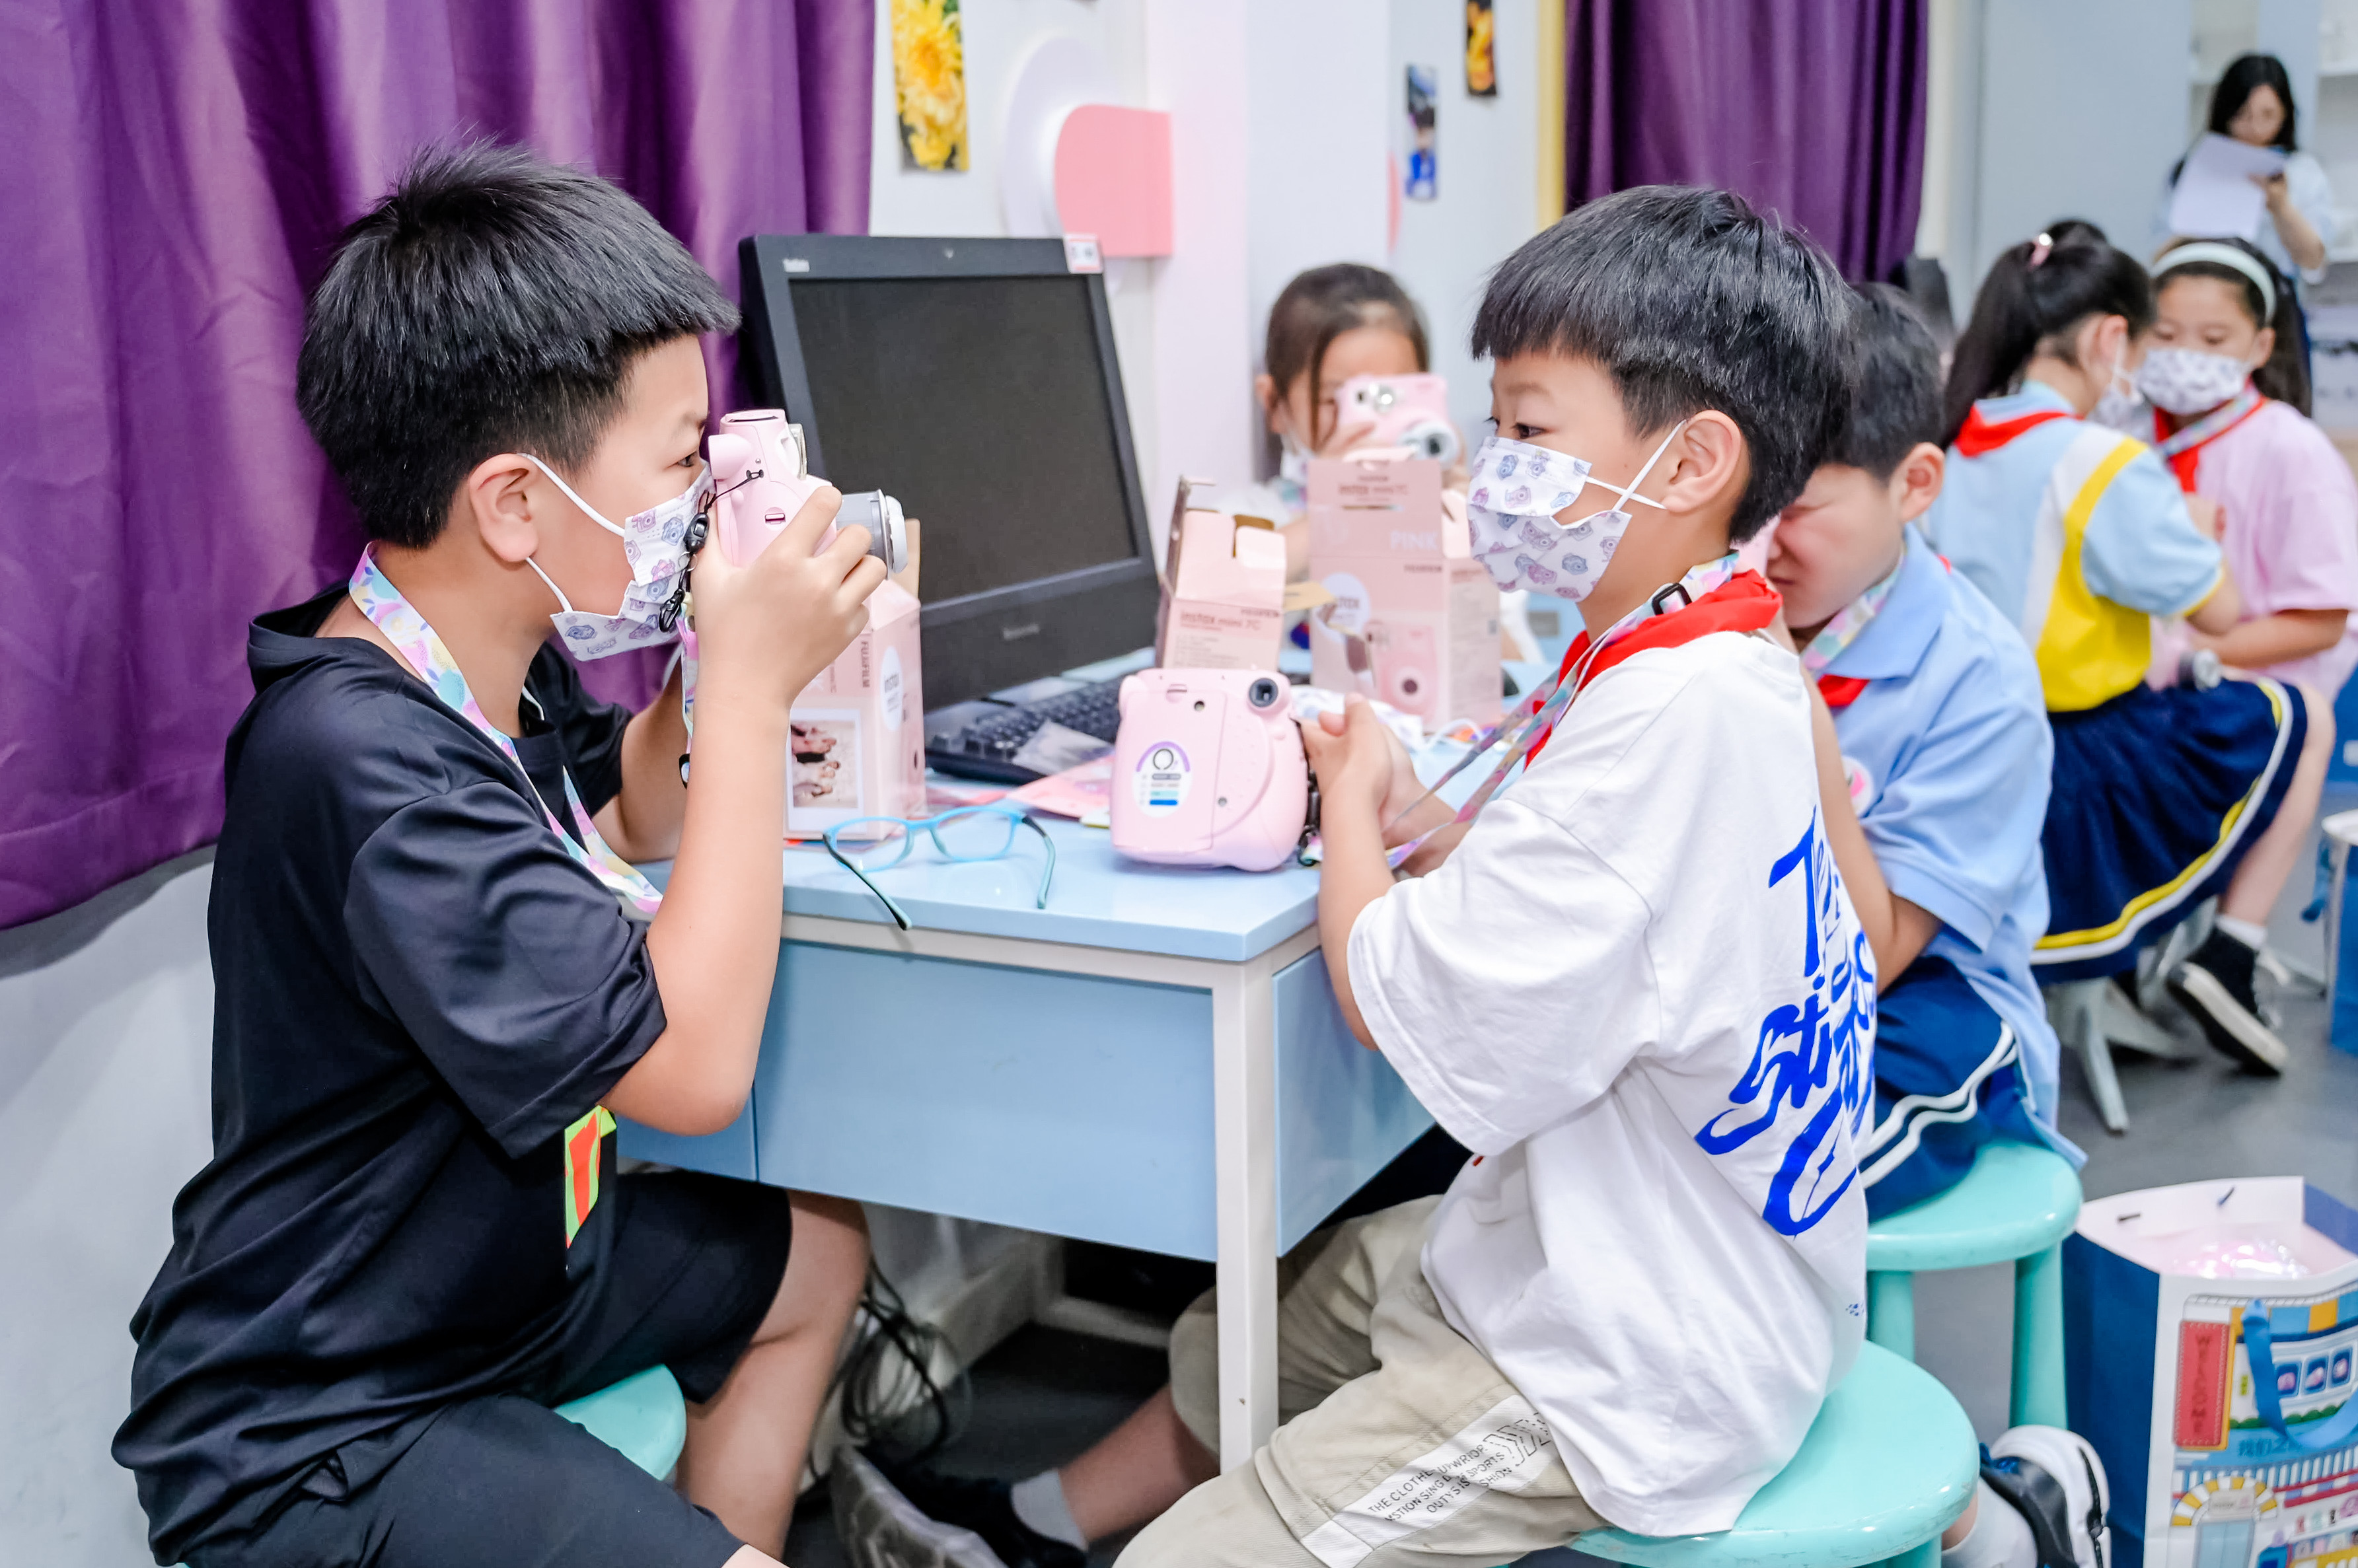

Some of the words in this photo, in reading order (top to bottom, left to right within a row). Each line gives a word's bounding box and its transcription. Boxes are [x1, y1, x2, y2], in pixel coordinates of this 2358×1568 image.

[1390, 531, 1438, 550] PINK
[1368, 1495, 1393, 1514] THE
[1389, 1469, 1438, 1503] CLOTHE
